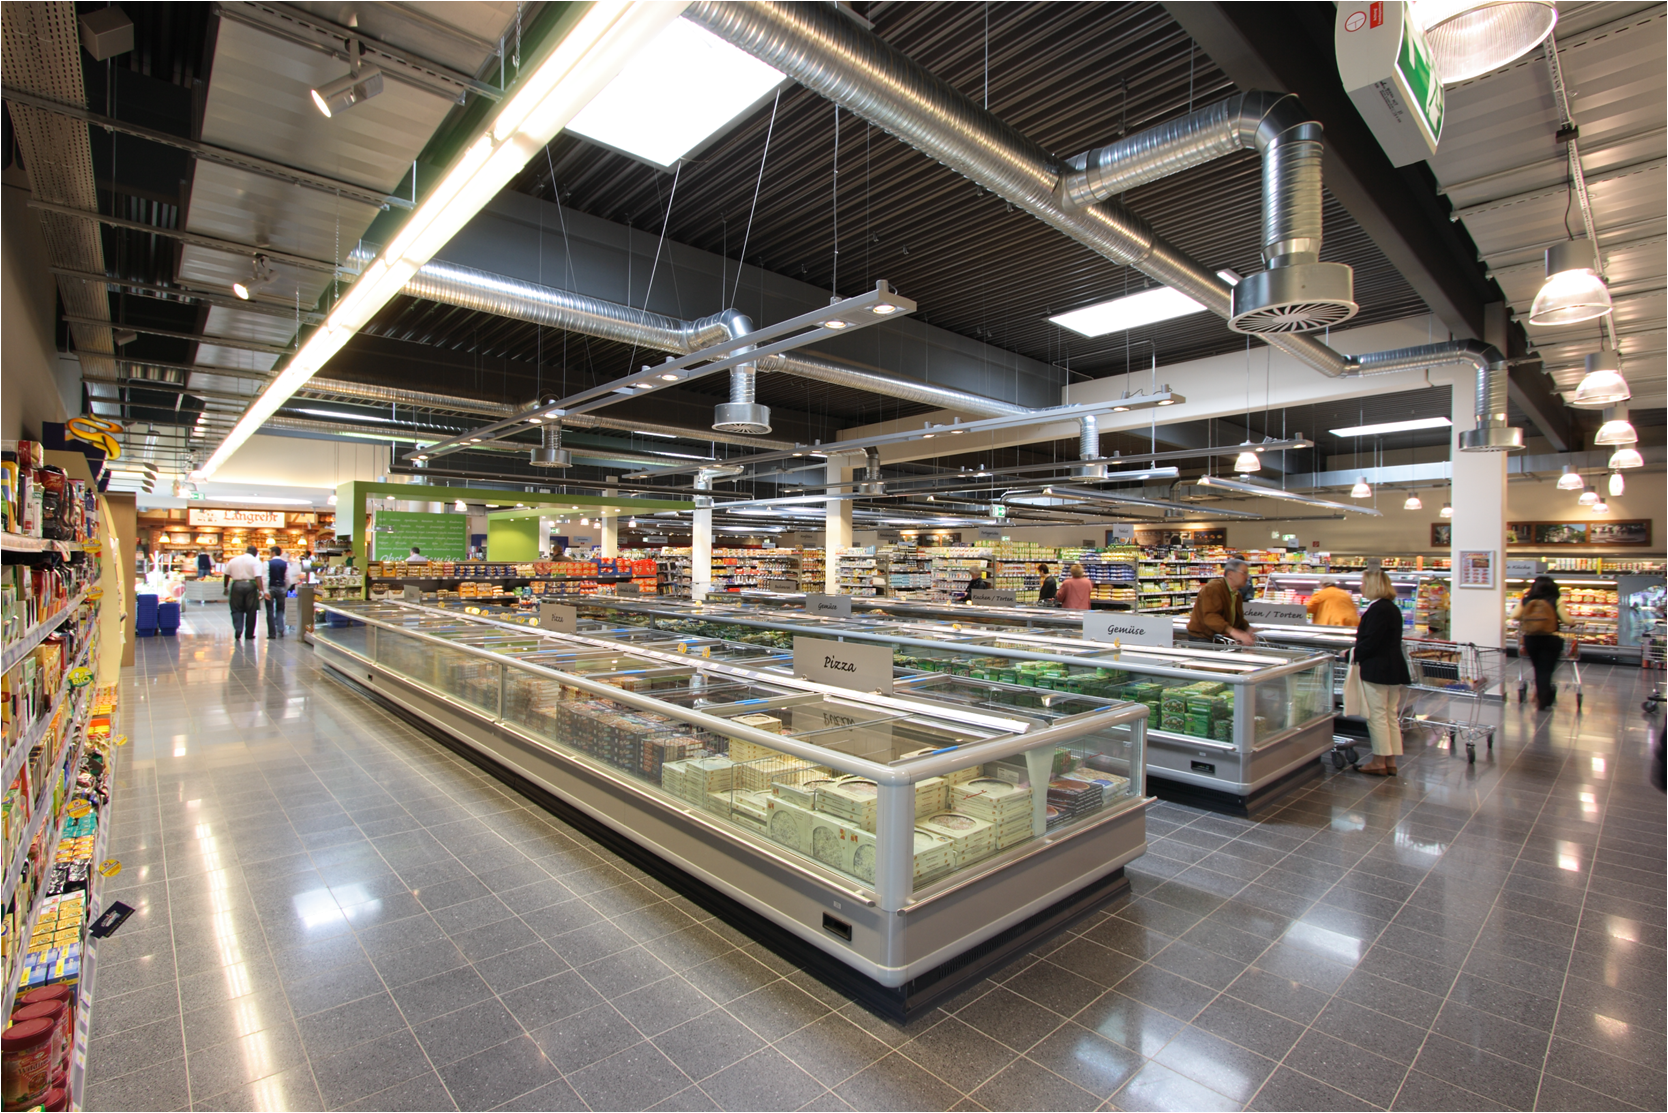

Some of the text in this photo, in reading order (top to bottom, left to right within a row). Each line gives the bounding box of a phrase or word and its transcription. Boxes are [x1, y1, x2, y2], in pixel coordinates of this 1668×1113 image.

[223, 510, 278, 524] Langrehr
[818, 602, 838, 610] Gemüse
[551, 613, 563, 622] Pizza
[1244, 609, 1264, 617] chen
[1273, 611, 1303, 619] Torten
[1107, 624, 1146, 635] Gemüse
[823, 655, 857, 673] Pizza
[72, 676, 90, 685] BIO
